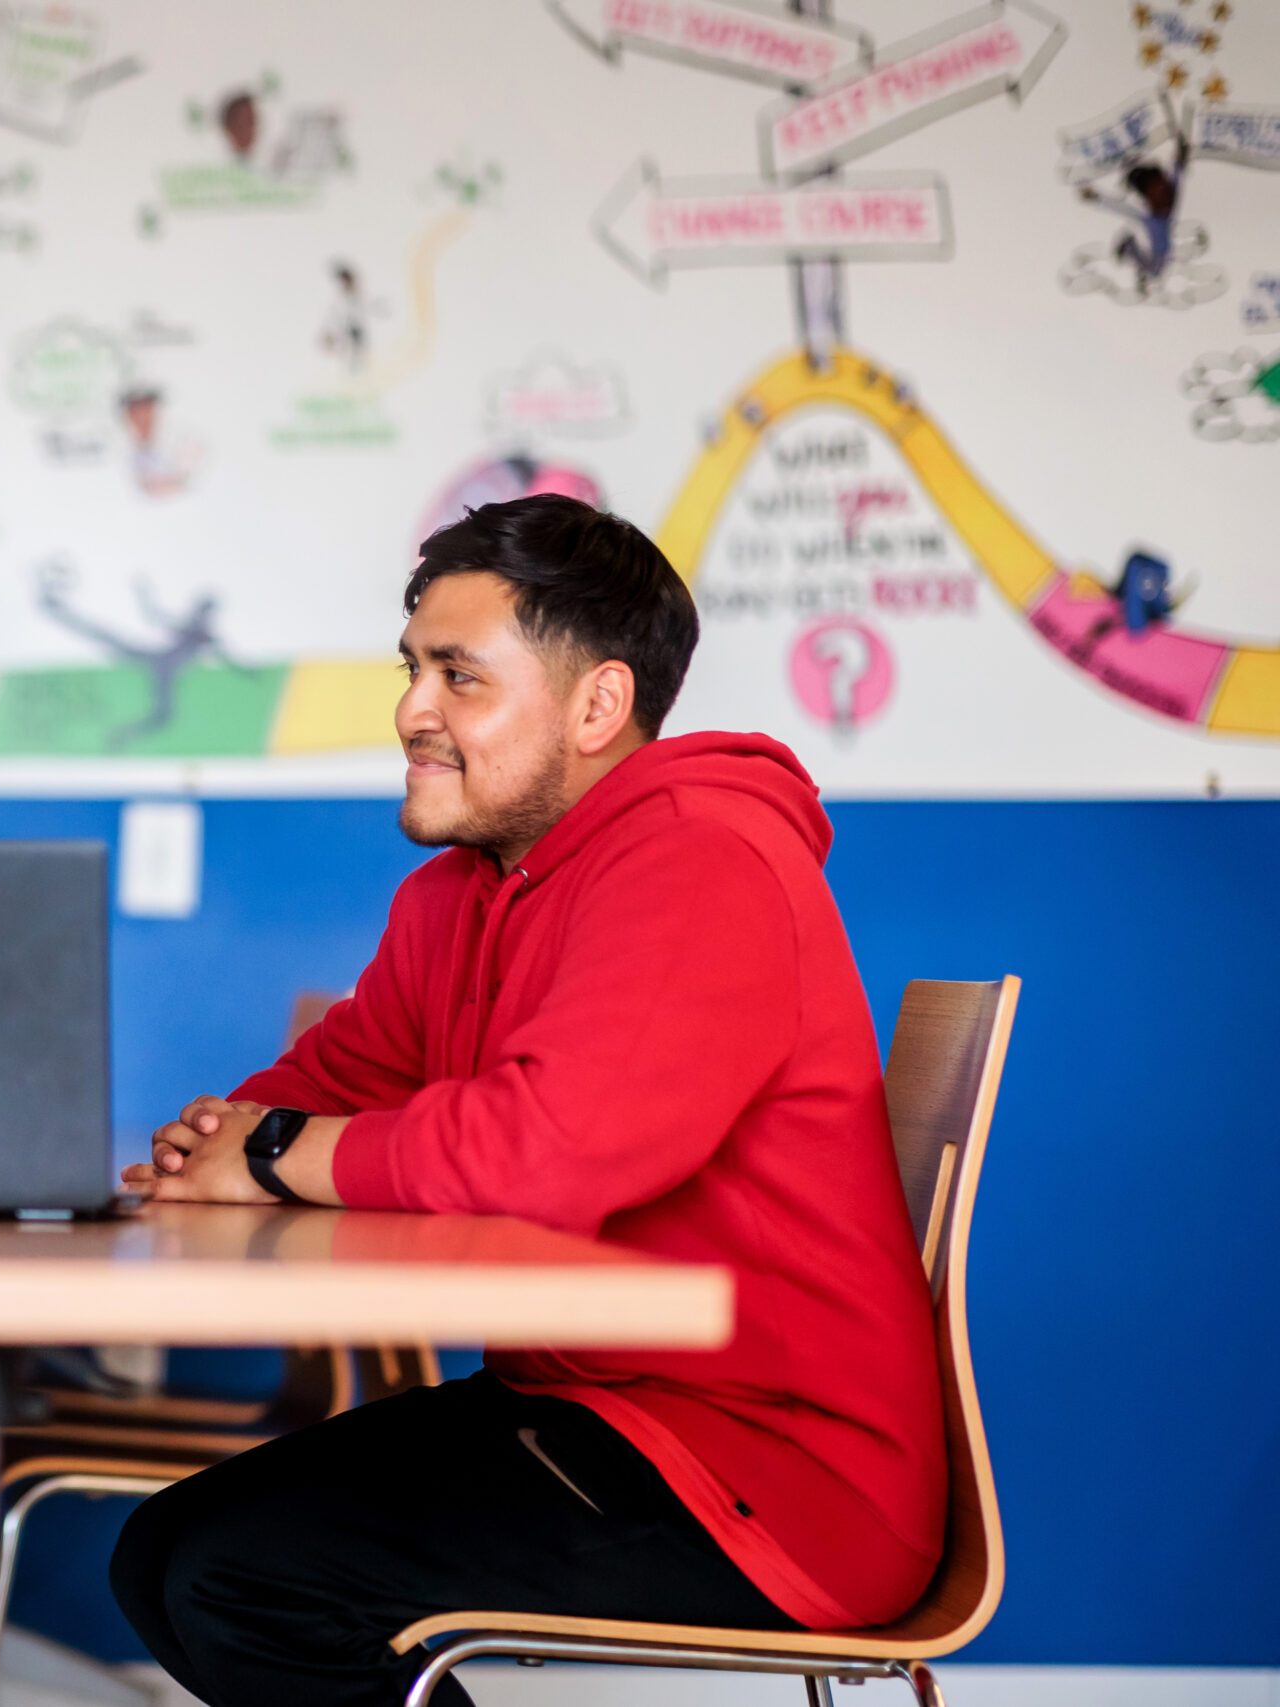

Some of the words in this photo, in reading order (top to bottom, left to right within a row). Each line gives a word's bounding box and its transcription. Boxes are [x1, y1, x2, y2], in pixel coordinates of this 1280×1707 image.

[780, 84, 865, 149] KEEP
[874, 25, 1022, 104] PUSHING
[650, 196, 784, 240] CHANGE
[800, 193, 927, 236] COURSE
